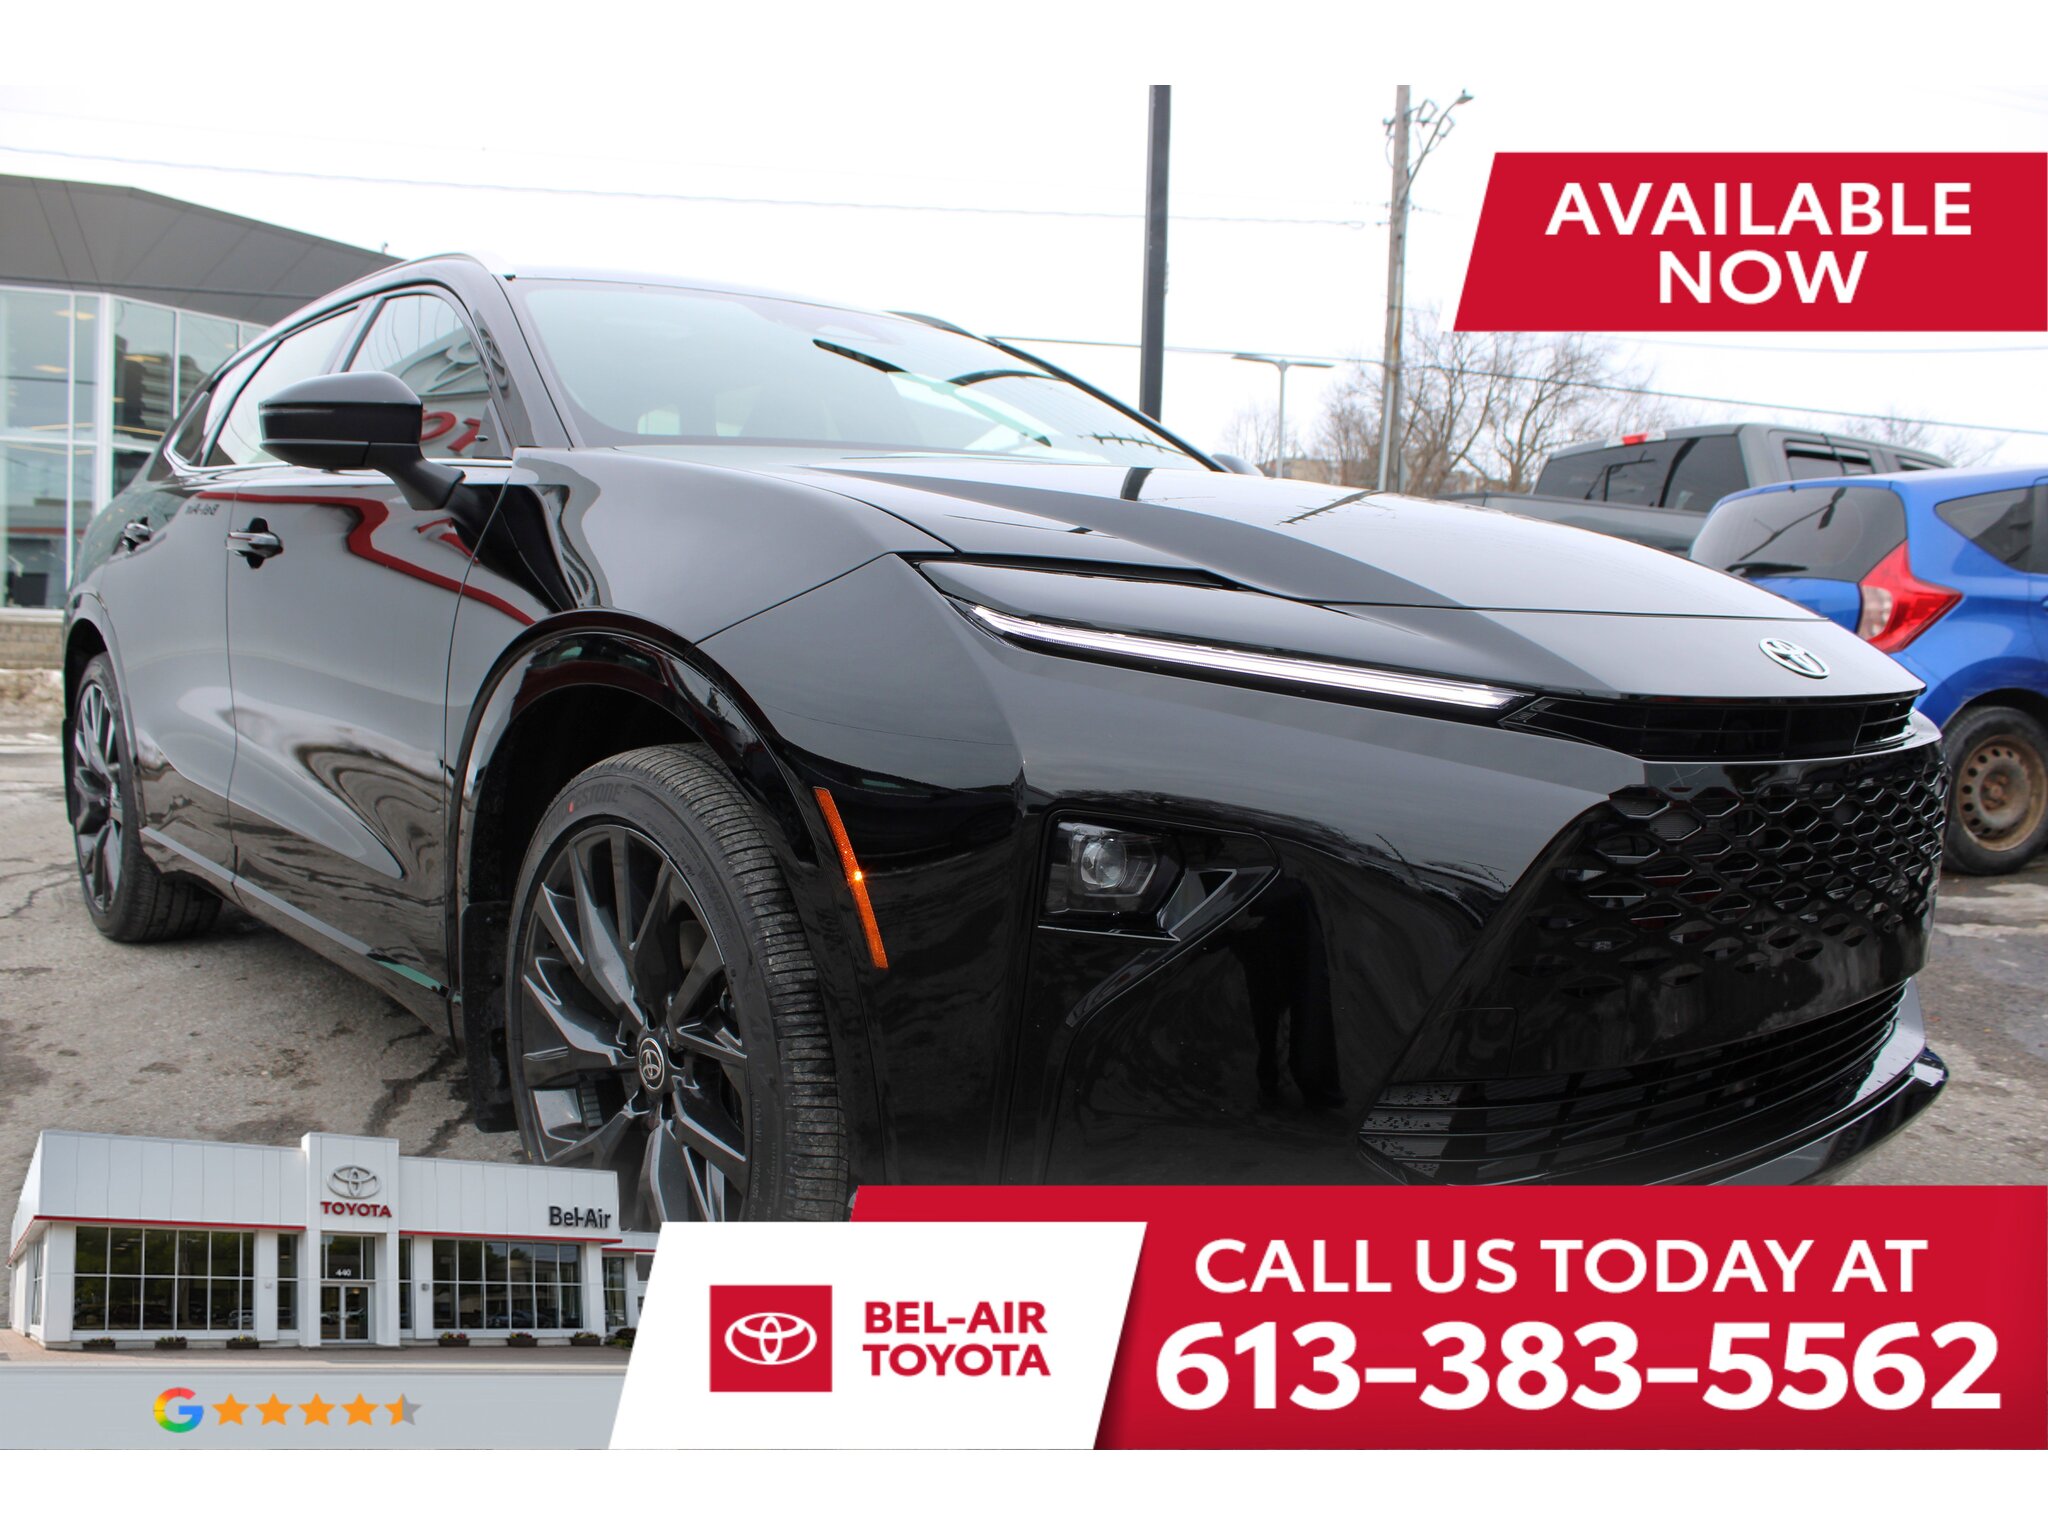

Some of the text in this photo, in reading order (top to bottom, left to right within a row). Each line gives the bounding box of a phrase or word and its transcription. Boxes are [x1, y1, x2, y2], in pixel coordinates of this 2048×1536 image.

[322, 1201, 392, 1218] TOYOTA
[548, 1205, 612, 1229] Bel-Air
[336, 1269, 352, 1277] 440
